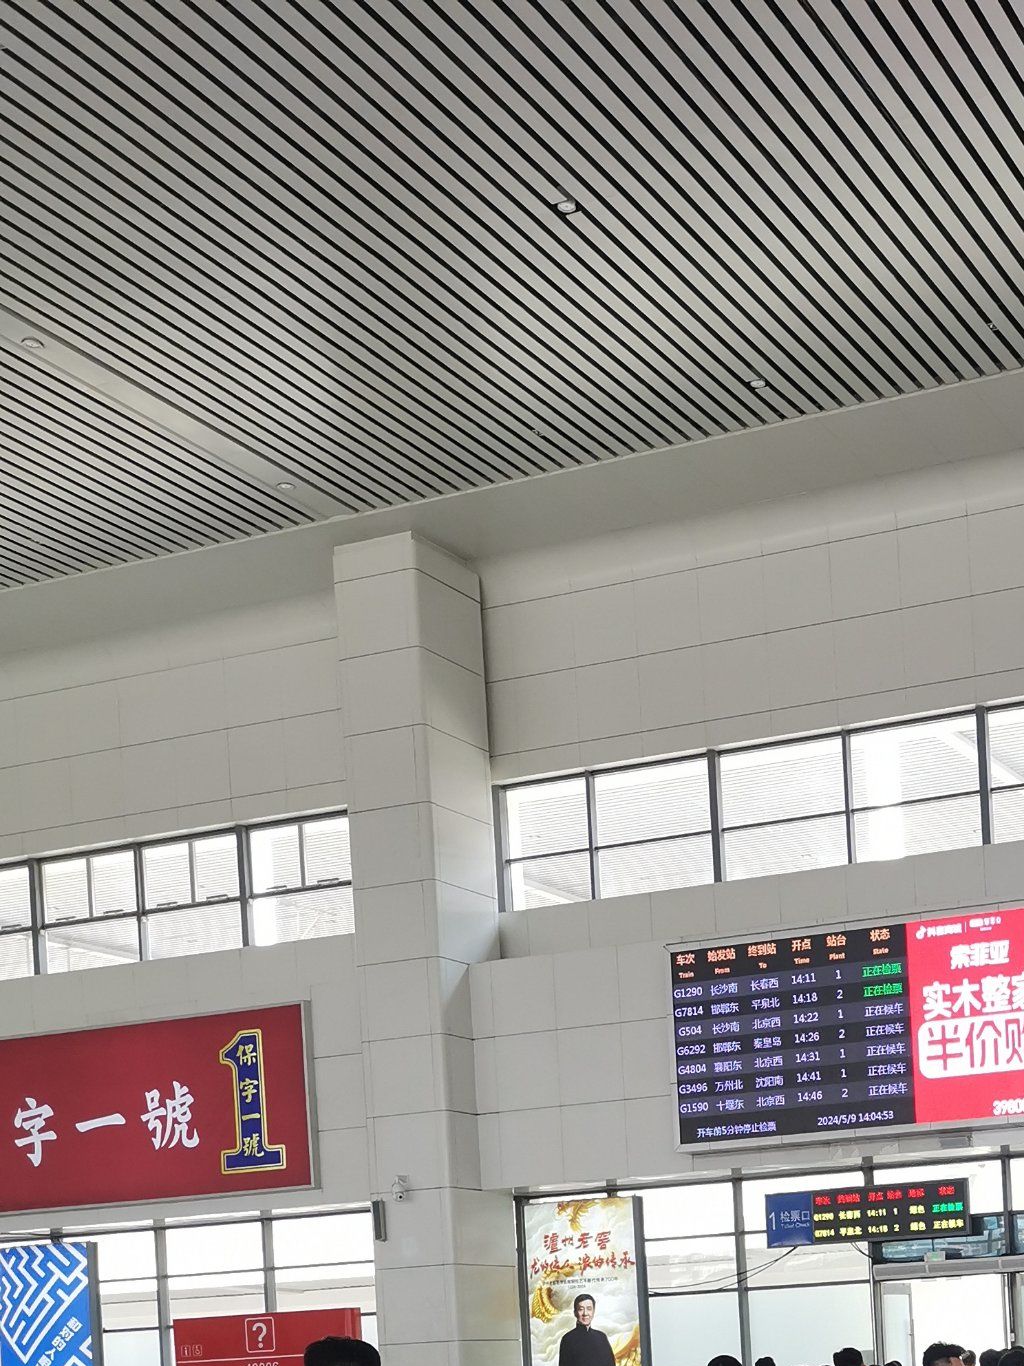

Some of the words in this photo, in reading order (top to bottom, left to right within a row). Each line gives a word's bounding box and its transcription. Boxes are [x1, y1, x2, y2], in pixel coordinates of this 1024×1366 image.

[676, 953, 695, 966] 车次
[707, 948, 736, 962] 始发站
[748, 943, 776, 957] 终到站
[791, 939, 811, 952] 开点
[826, 934, 846, 947] 站台
[870, 928, 890, 941] 状态
[674, 987, 702, 998] G1290
[710, 982, 738, 996] 长沙南
[750, 977, 779, 991] 长春西
[791, 973, 816, 984] 14:11
[836, 970, 841, 979] 1
[862, 963, 902, 977] 正在检票
[675, 1006, 704, 1017] G7814
[711, 1002, 739, 1015] 邯郸东
[751, 997, 780, 1010] 平泉北
[793, 992, 818, 1004] 14:18
[837, 989, 843, 999] 2
[864, 983, 903, 997] 正在检票
[678, 1025, 702, 1036] G504
[712, 1021, 740, 1035] 长沙南
[752, 1016, 781, 1030] 北京西
[793, 1012, 819, 1024] 14:22
[838, 1009, 843, 1018] 1
[864, 1002, 903, 1017] 正在候车
[677, 1044, 706, 1056] G6292
[713, 1041, 741, 1053] 邯郸东
[753, 1036, 781, 1049] 秦皇岛
[795, 1032, 820, 1043] 14:26
[839, 1029, 845, 1038] 2
[866, 1022, 904, 1037] 正在候车
[678, 1064, 706, 1075] G4804
[714, 1060, 742, 1073] 襄阳东
[754, 1055, 783, 1068] 北京西
[796, 1051, 820, 1063] 14:31
[840, 1049, 846, 1058] 1
[866, 1042, 906, 1057] 正在候车
[679, 1082, 708, 1094] G3496
[715, 1079, 743, 1092] 万州北
[755, 1075, 783, 1088] 沈阳南
[797, 1071, 821, 1082] 14:41
[841, 1069, 847, 1078] 1
[868, 1062, 906, 1076] 正在候车
[236, 1044, 265, 1157] 保字一號
[680, 1102, 709, 1113] G1590
[716, 1099, 744, 1111] 十堰东
[756, 1094, 785, 1107] 北京西
[798, 1091, 823, 1102] 14:46
[842, 1088, 848, 1098] 2
[868, 1082, 908, 1096] 正在候车
[697, 1121, 776, 1138] 开车前5分钟停止检票
[817, 1114, 856, 1126] 2024/5/9
[858, 1110, 894, 1122] 14:04:53
[769, 1212, 776, 1230] 1
[780, 1210, 810, 1222] 检票口
